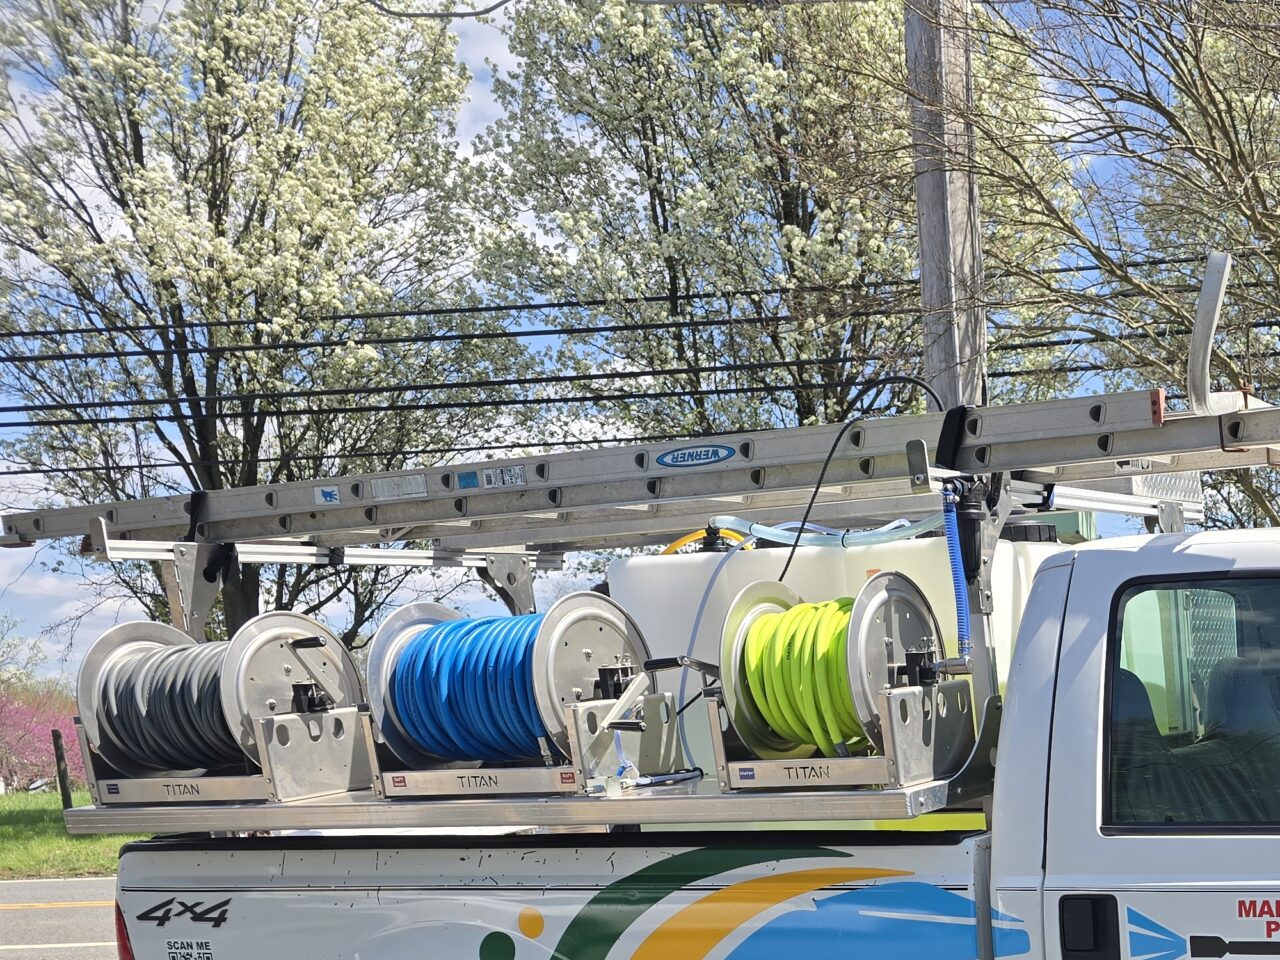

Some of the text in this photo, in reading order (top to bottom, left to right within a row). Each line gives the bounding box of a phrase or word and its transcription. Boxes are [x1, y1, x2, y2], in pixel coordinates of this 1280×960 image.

[671, 448, 721, 464] WERNER
[783, 766, 830, 780] TITAN
[456, 775, 499, 789] TITAN
[163, 784, 200, 796] TITAN
[136, 897, 232, 928] 4x4
[166, 941, 212, 951] SCAN ME
